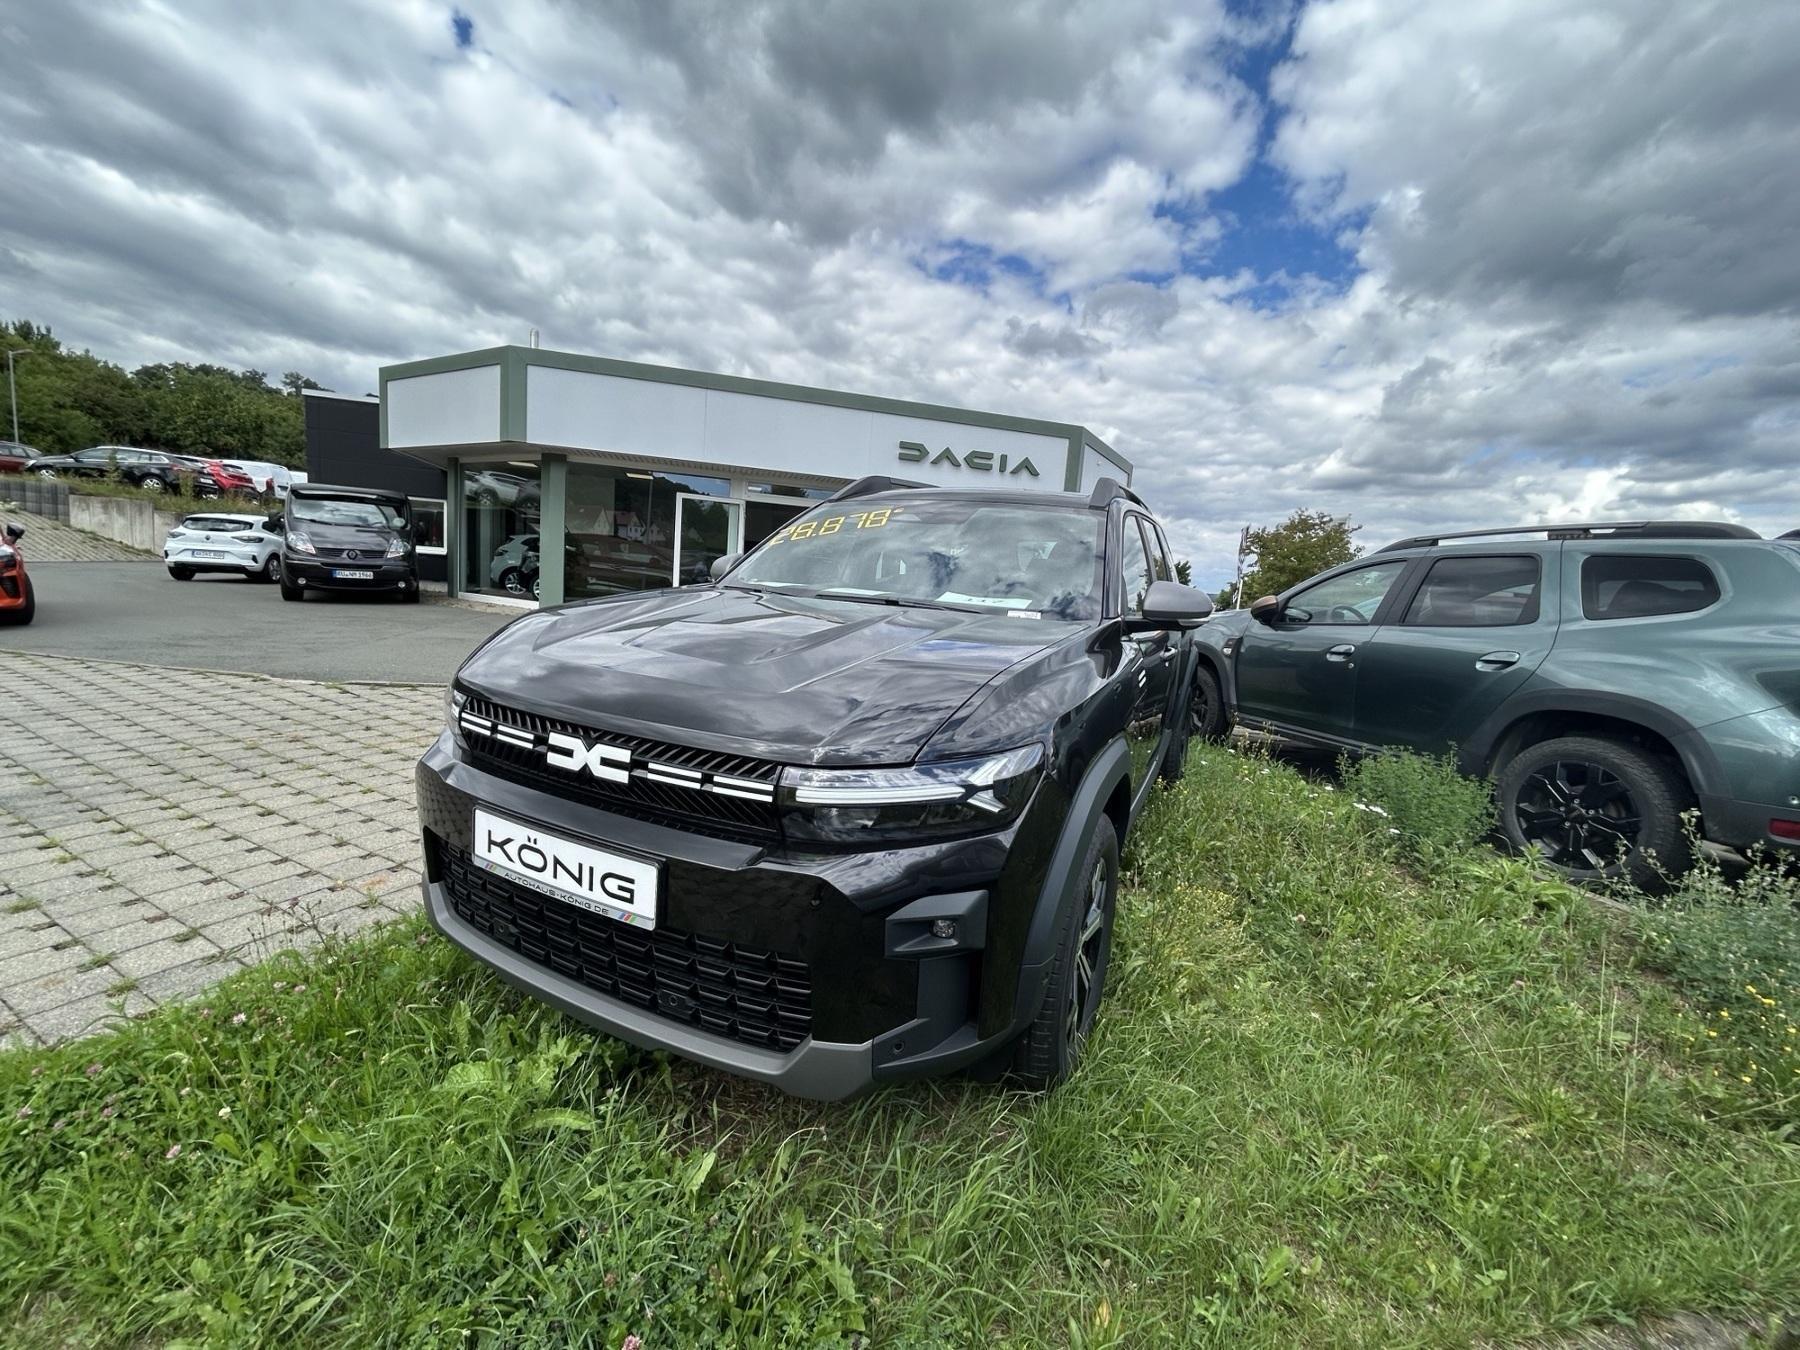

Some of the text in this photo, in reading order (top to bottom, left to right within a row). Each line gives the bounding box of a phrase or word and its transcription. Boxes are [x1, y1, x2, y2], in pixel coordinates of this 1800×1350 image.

[898, 440, 1040, 477] DACIA
[487, 829, 636, 905] KÖNIG
[504, 872, 610, 916] AUTOHAUS-KÖNIGDE
